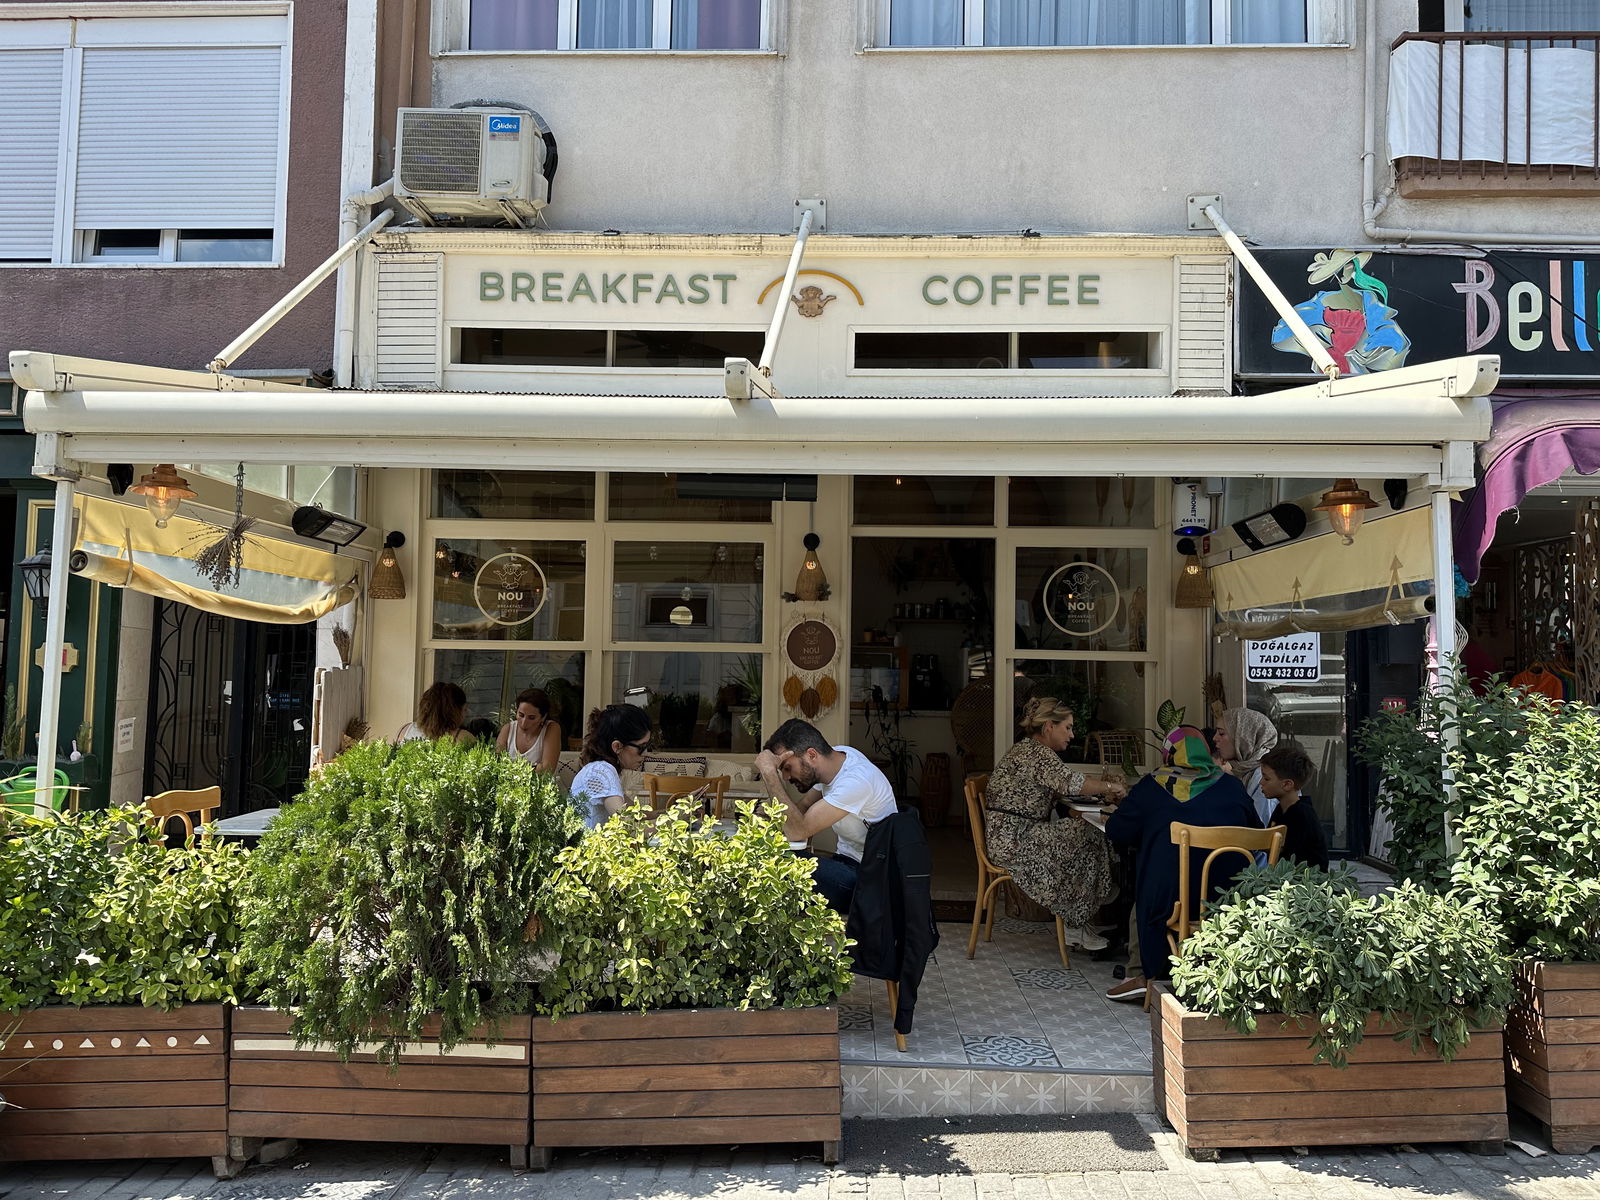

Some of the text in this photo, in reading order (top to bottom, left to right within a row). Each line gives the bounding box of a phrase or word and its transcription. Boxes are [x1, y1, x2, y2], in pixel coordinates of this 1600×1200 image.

[492, 119, 517, 130] Midea
[480, 272, 1100, 305] BREAKFAST COFFEE
[1451, 259, 1600, 352] Bell
[497, 592, 523, 601] NOU
[1068, 602, 1095, 611] NOU
[803, 646, 820, 654] NOU
[1251, 640, 1314, 650] DOĞALGAZ
[1259, 653, 1306, 663] TADİLAT
[1251, 668, 1316, 678] 0543 432 03 61
